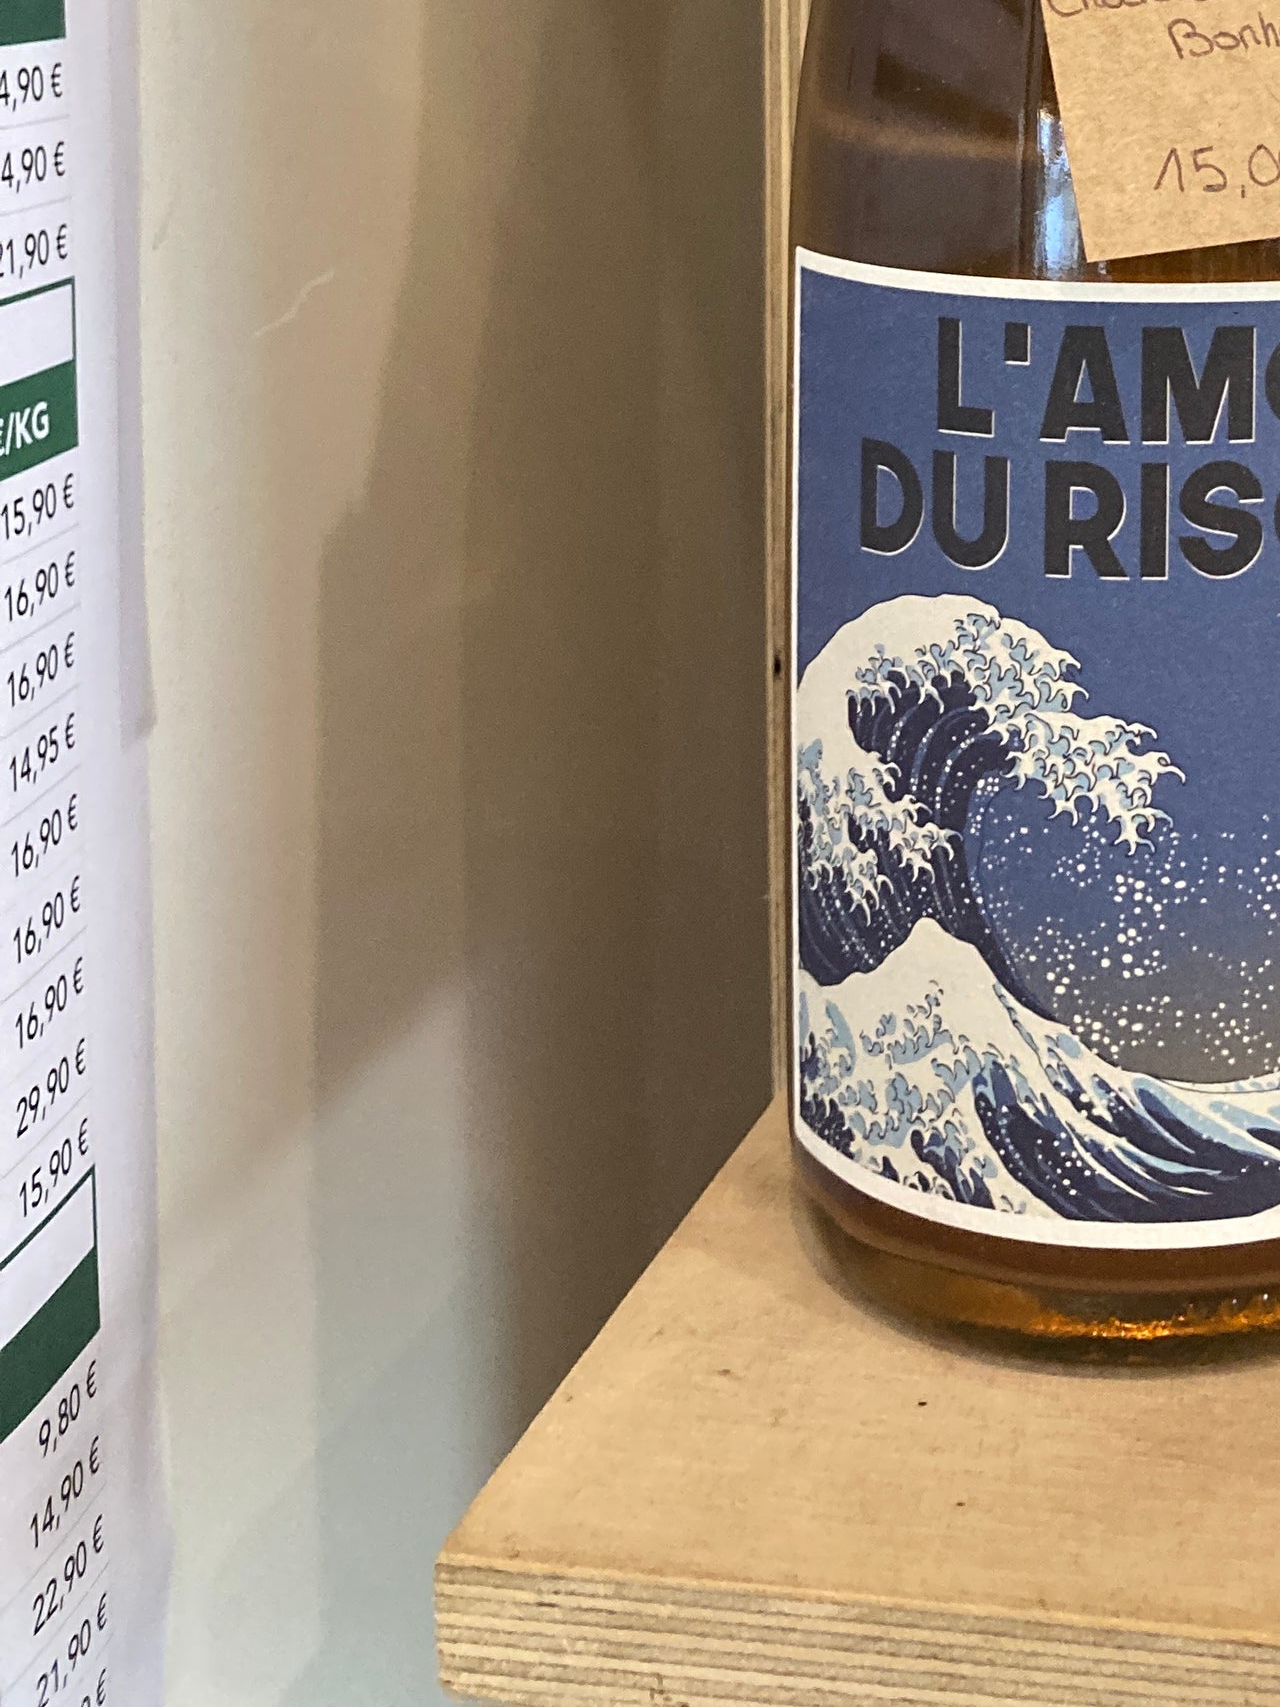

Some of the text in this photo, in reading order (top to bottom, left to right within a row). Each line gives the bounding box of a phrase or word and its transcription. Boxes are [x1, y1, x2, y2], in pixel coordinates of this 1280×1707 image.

[0, 482, 58, 541] 15,90
[859, 437, 1010, 572] DU
[4, 561, 59, 623] 16,90
[6, 643, 59, 708] 16,90
[8, 723, 60, 793] 14,95
[10, 808, 63, 878] 16,90
[12, 891, 65, 965] 16,90
[14, 973, 68, 1050] 16,90
[15, 1055, 70, 1139] 29,90
[18, 1137, 73, 1218] 15,90
[38, 1383, 81, 1460] 9,80
[28, 1458, 85, 1551] 14,90
[31, 1539, 88, 1637] 22,90
[35, 1618, 91, 1707] 21,90
